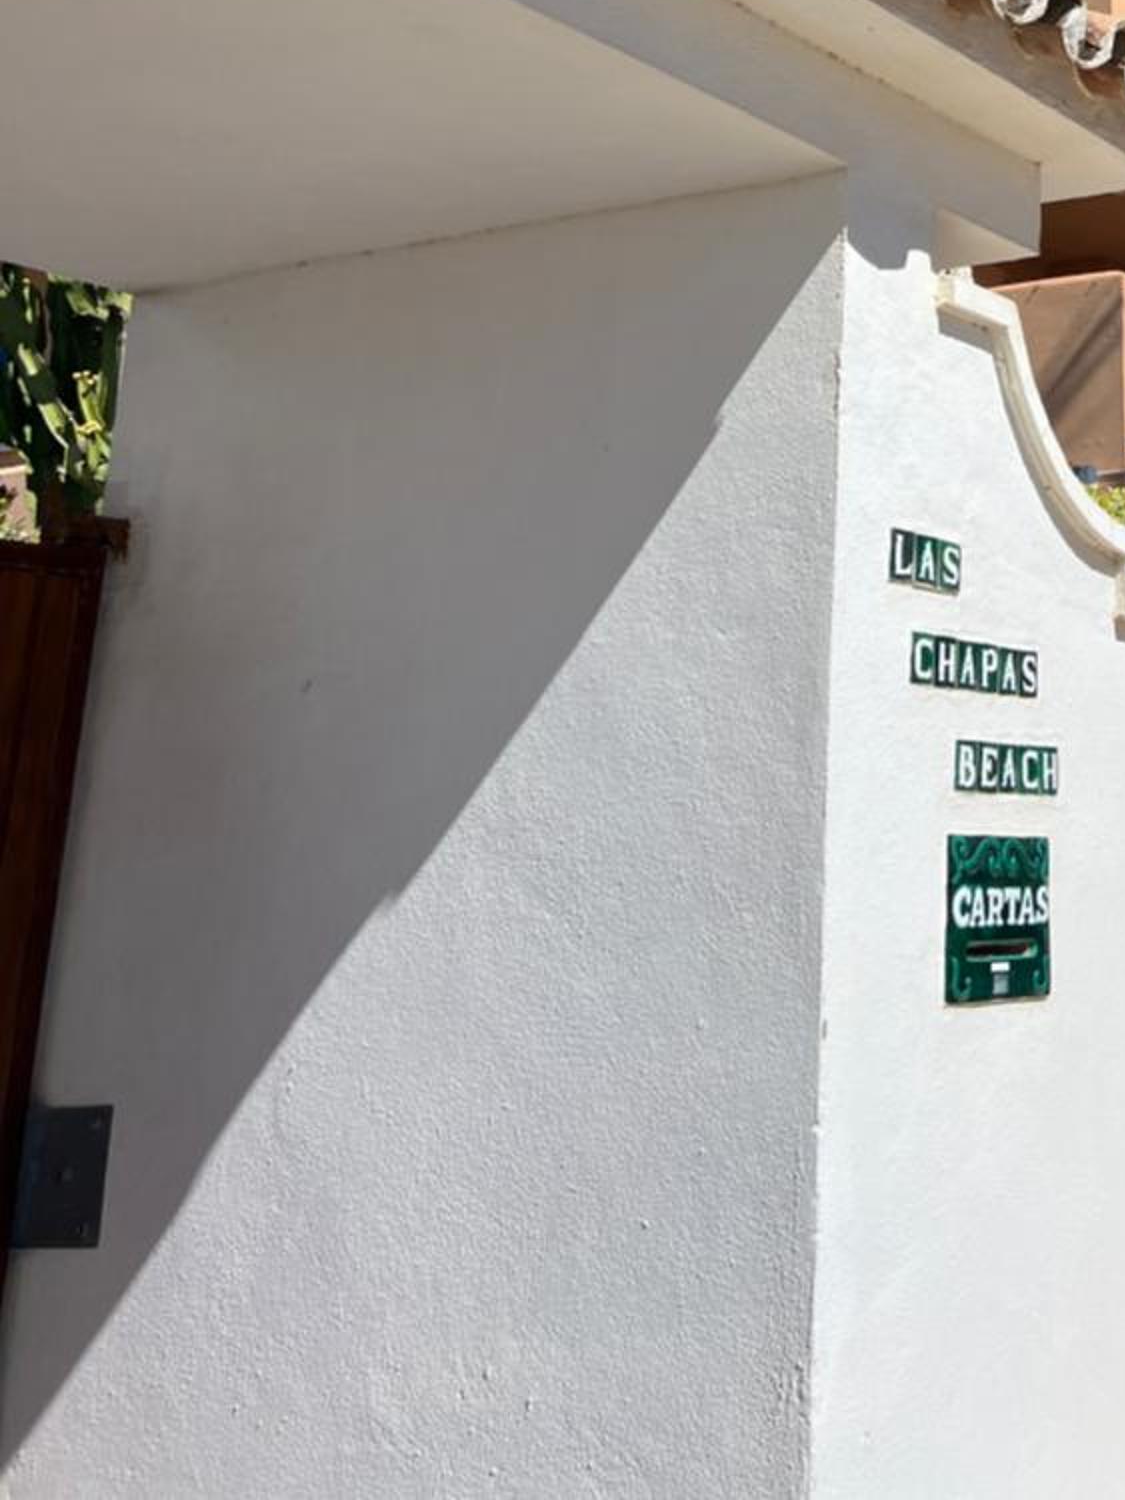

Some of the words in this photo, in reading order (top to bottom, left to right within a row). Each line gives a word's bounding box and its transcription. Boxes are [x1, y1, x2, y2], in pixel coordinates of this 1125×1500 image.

[894, 534, 960, 585] LAS
[914, 638, 1036, 693] CHAPAS
[957, 744, 1057, 790] BEACH
[952, 885, 1049, 928] CARTAS
